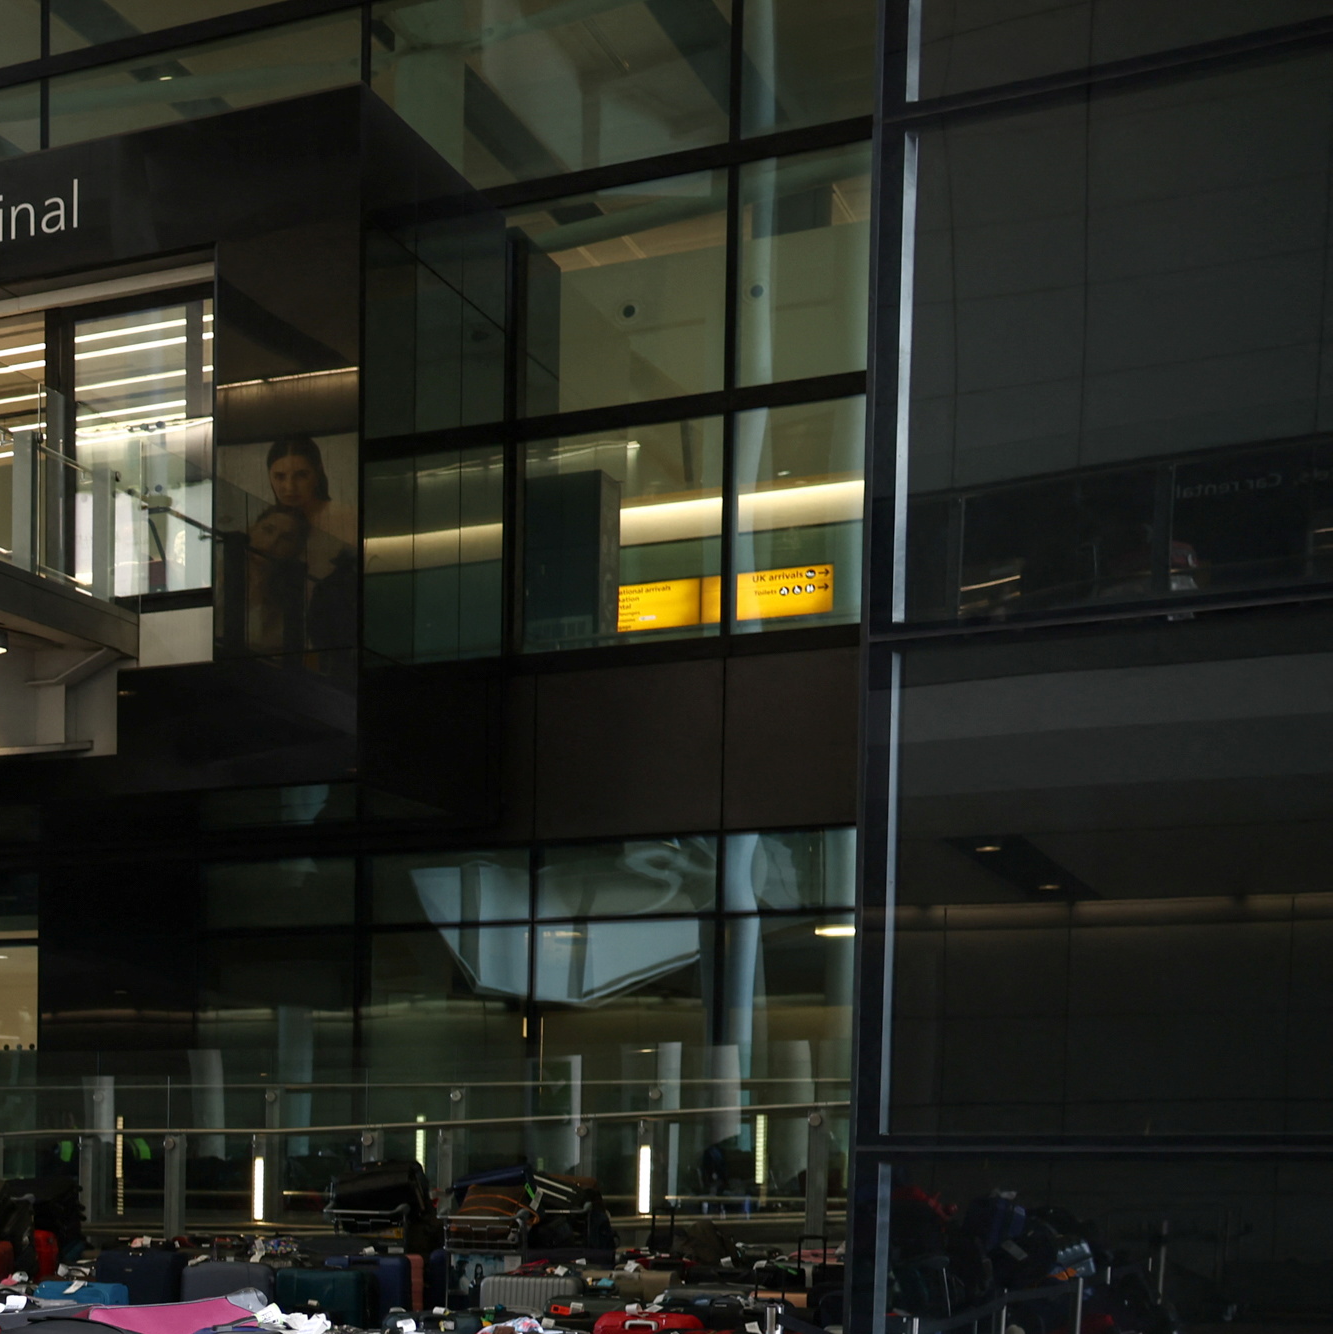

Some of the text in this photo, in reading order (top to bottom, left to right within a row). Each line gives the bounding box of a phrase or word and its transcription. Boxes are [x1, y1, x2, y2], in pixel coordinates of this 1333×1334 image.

[753, 571, 804, 583] UK arrivals
[645, 585, 671, 593] arrivals
